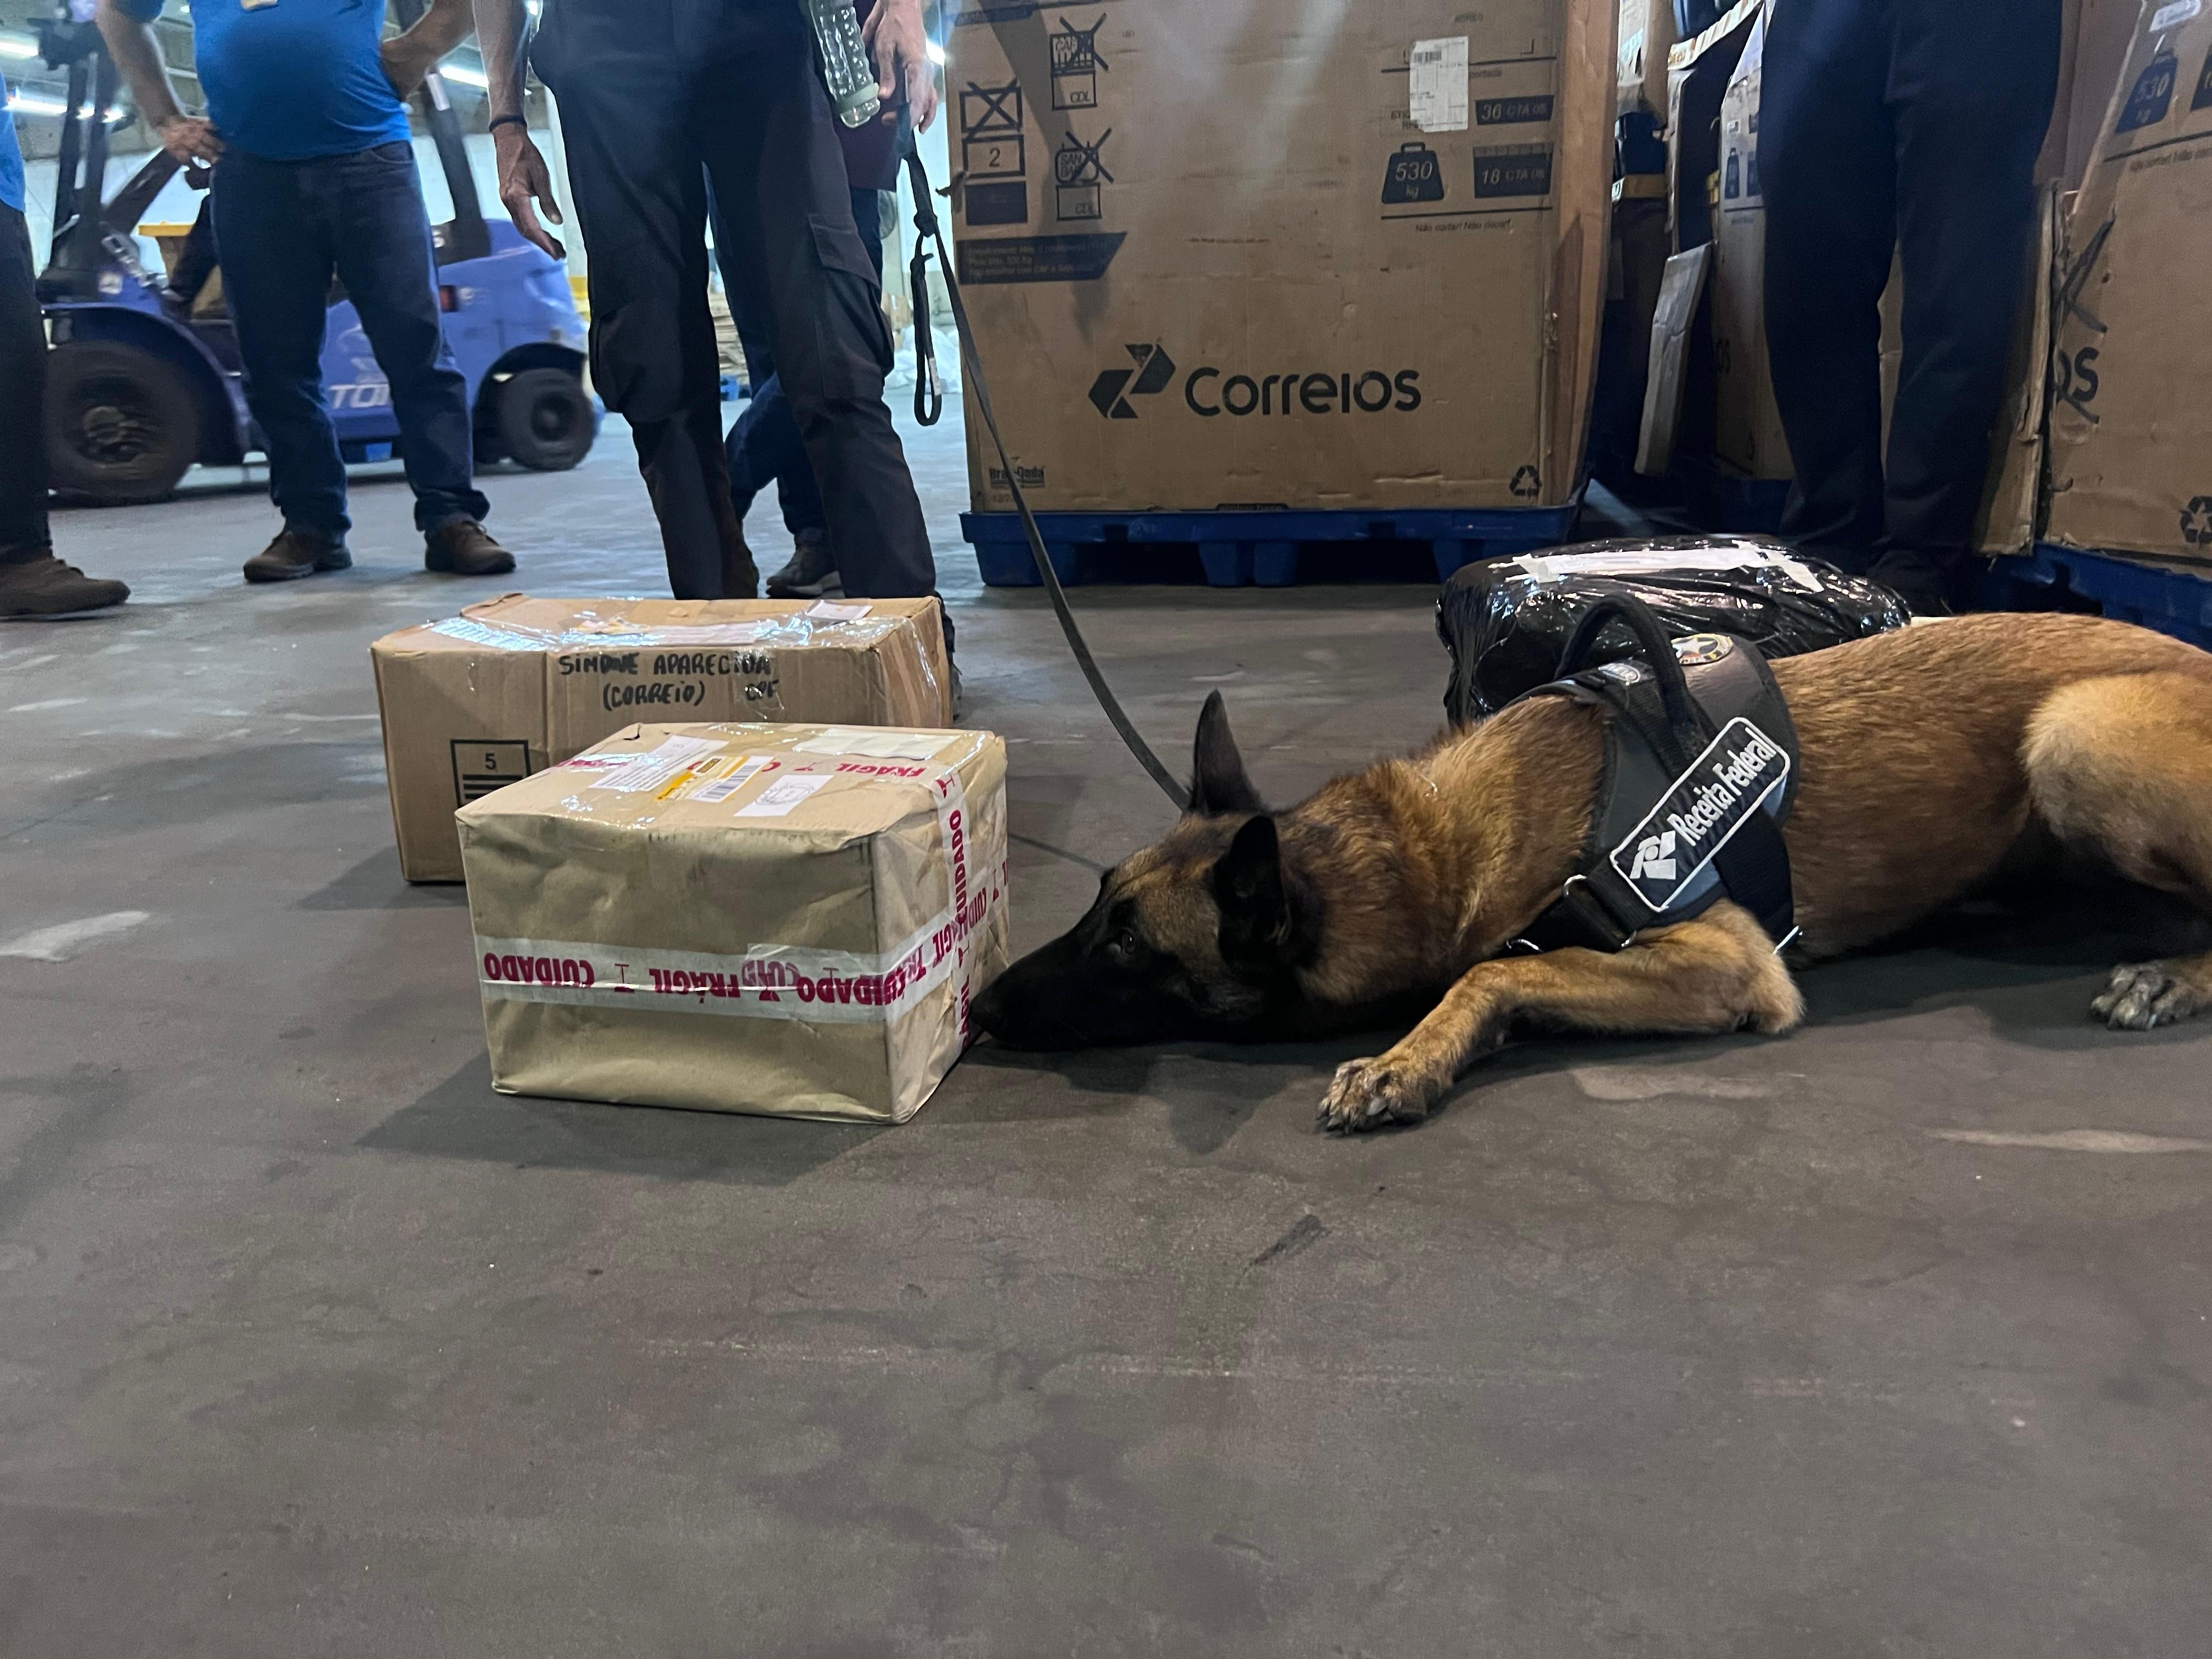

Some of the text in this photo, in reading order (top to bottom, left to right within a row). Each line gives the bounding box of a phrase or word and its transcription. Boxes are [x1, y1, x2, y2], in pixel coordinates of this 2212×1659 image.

[989, 149, 1000, 167] 2
[1395, 160, 1433, 182] 530
[1482, 168, 1500, 184] 18
[1185, 366, 1423, 416] Correios
[485, 752, 496, 770] 5
[1667, 726, 1777, 847] Receita Federal
[483, 952, 595, 988] CUIDADO
[648, 967, 741, 1004] FRÁGIL
